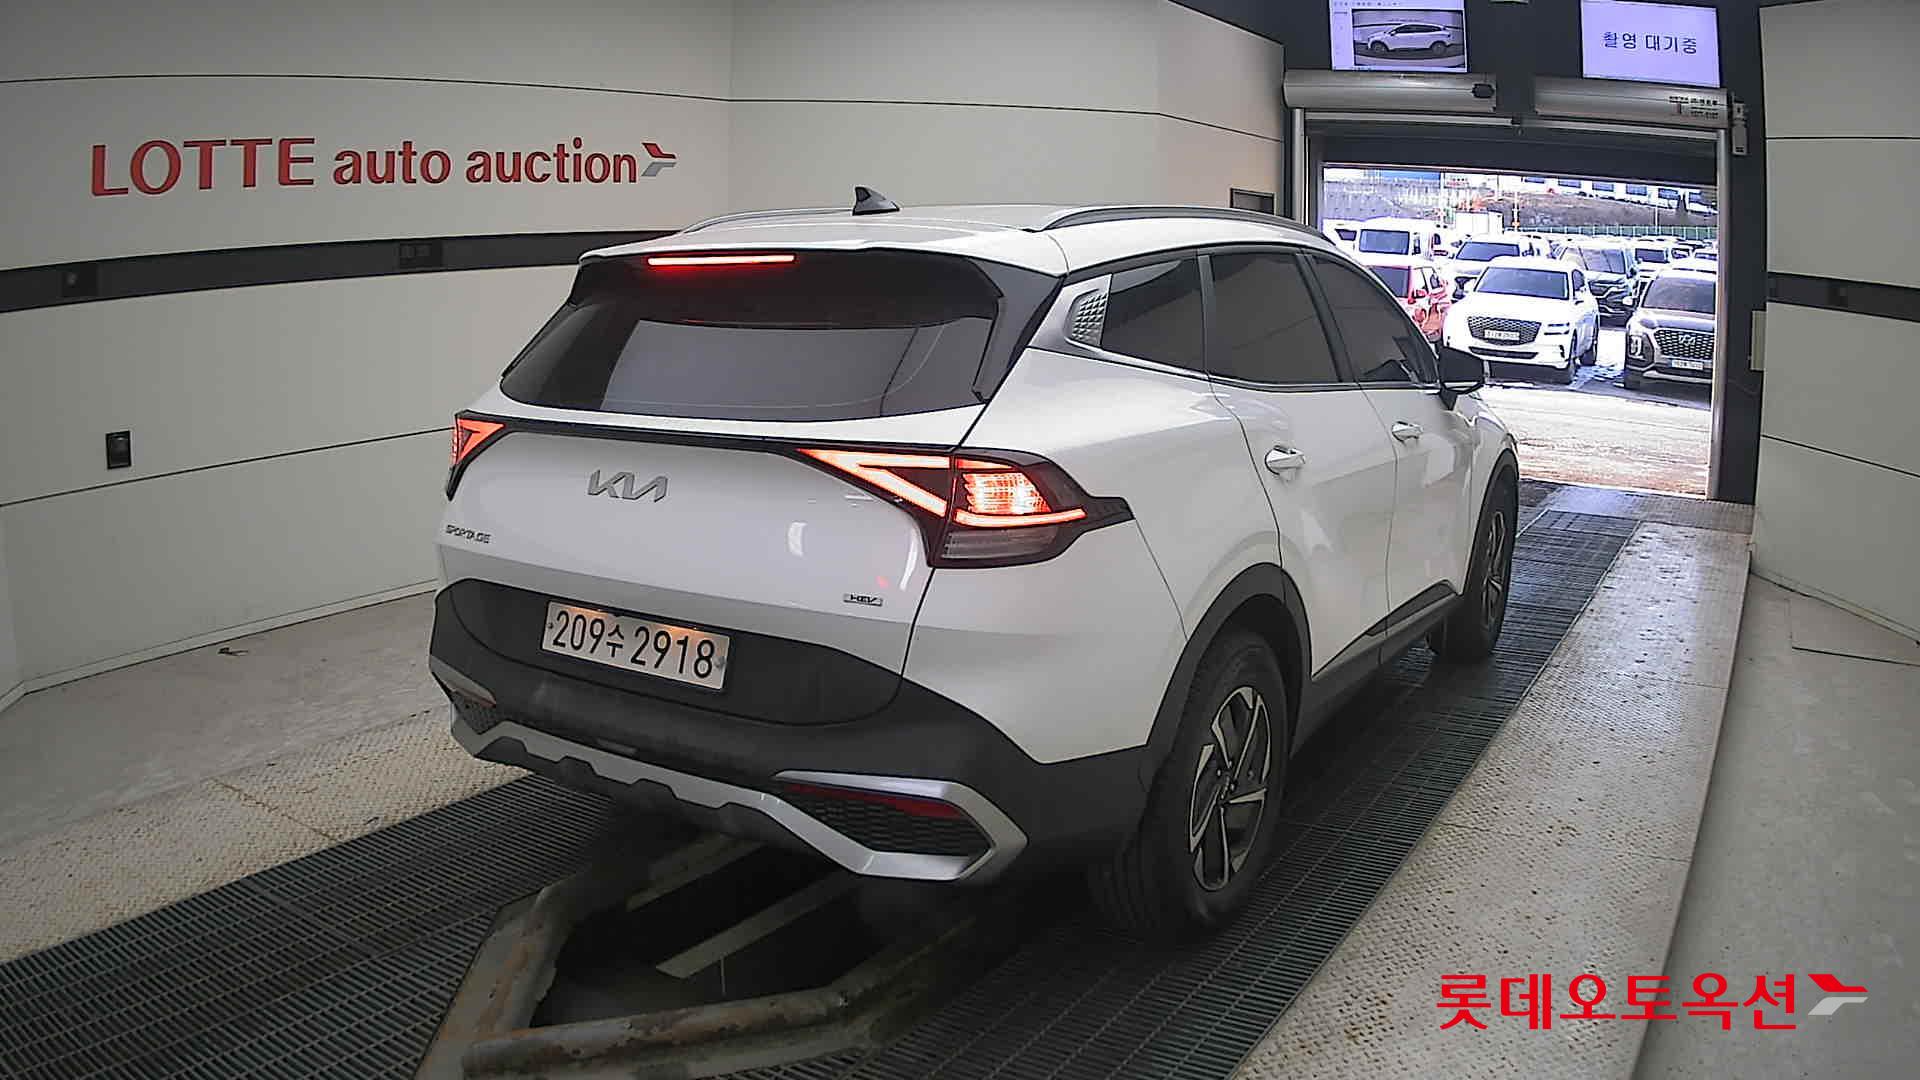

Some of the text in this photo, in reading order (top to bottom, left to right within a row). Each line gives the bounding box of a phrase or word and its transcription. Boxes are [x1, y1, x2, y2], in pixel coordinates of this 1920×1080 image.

[1644, 34, 1697, 55] 대기중
[91, 137, 637, 197] LOTTE auto auction
[586, 469, 669, 503] KIA
